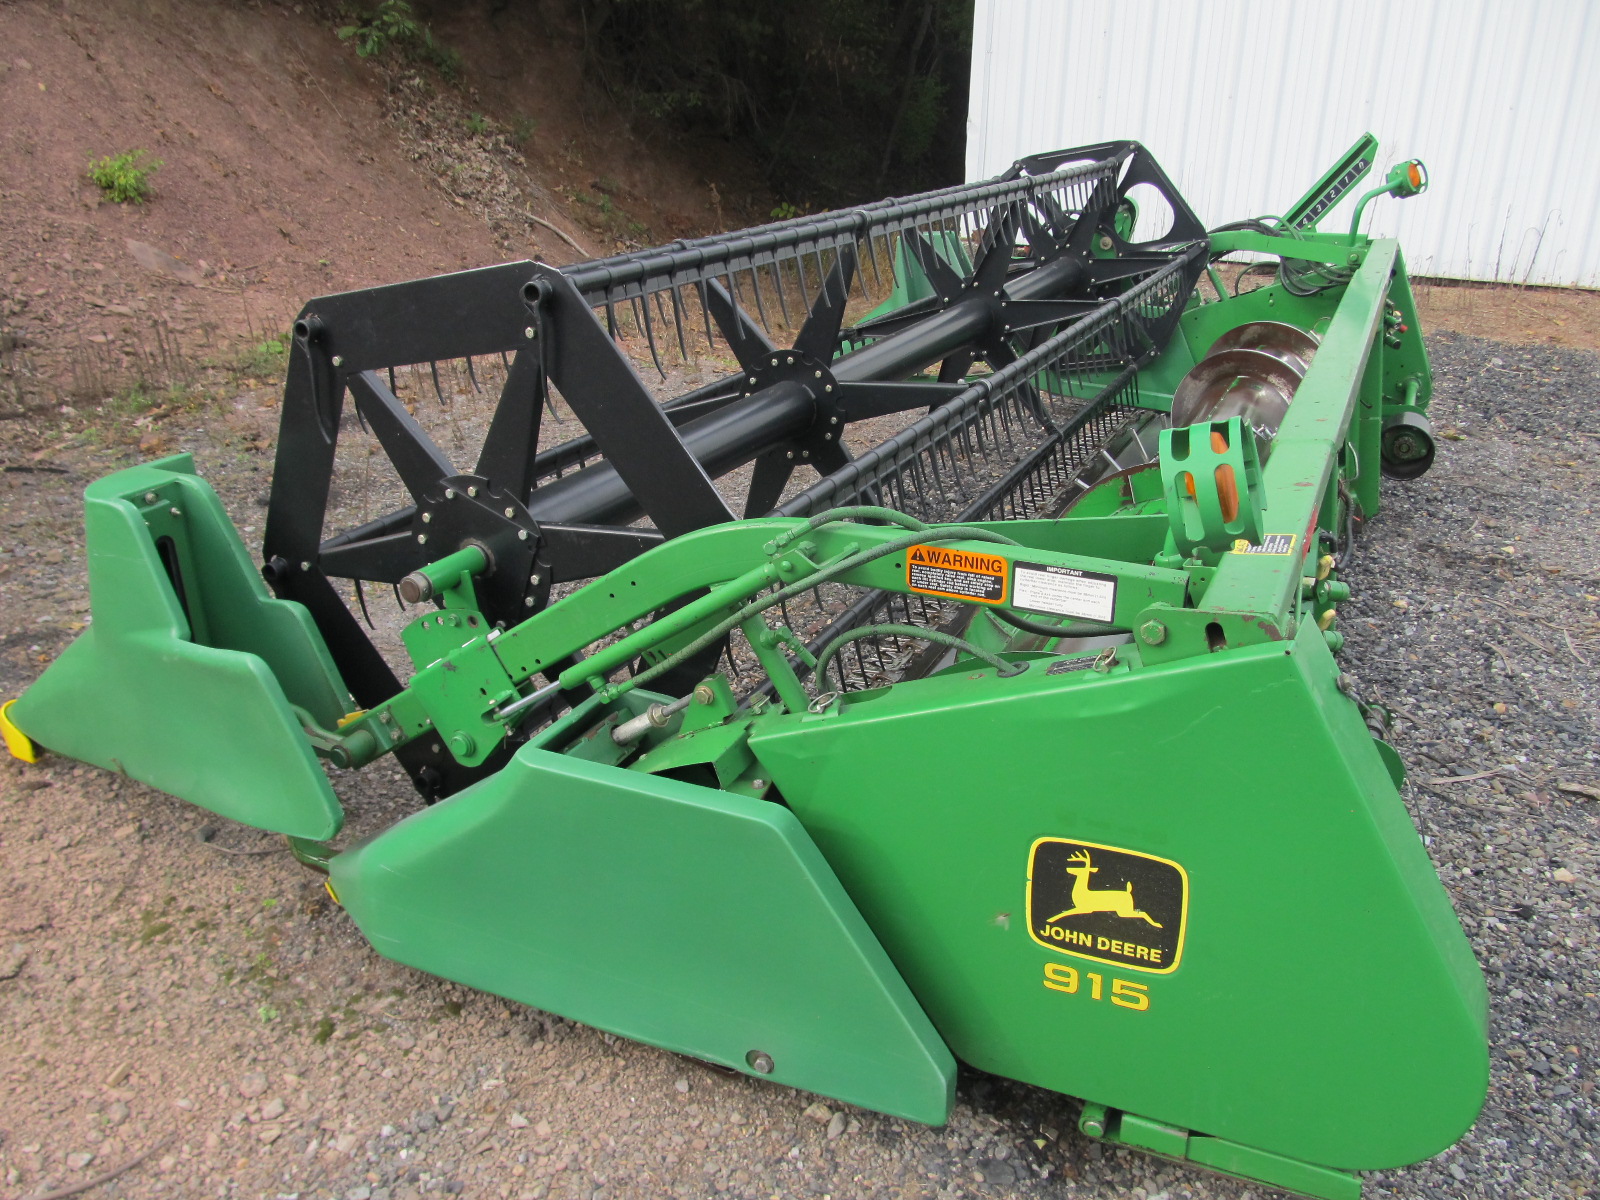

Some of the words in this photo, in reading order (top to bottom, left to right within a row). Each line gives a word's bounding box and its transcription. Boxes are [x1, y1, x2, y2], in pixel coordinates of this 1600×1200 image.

[1316, 204, 1322, 212] 3
[1330, 190, 1336, 198] 2
[1344, 176, 1350, 184] 1
[1359, 161, 1365, 170] 0
[927, 550, 1002, 573] WARNING
[1046, 566, 1083, 577] IMPORTANT
[1040, 924, 1092, 947] JOHN
[1097, 936, 1162, 963] DEERE
[1043, 962, 1150, 1011] 915
